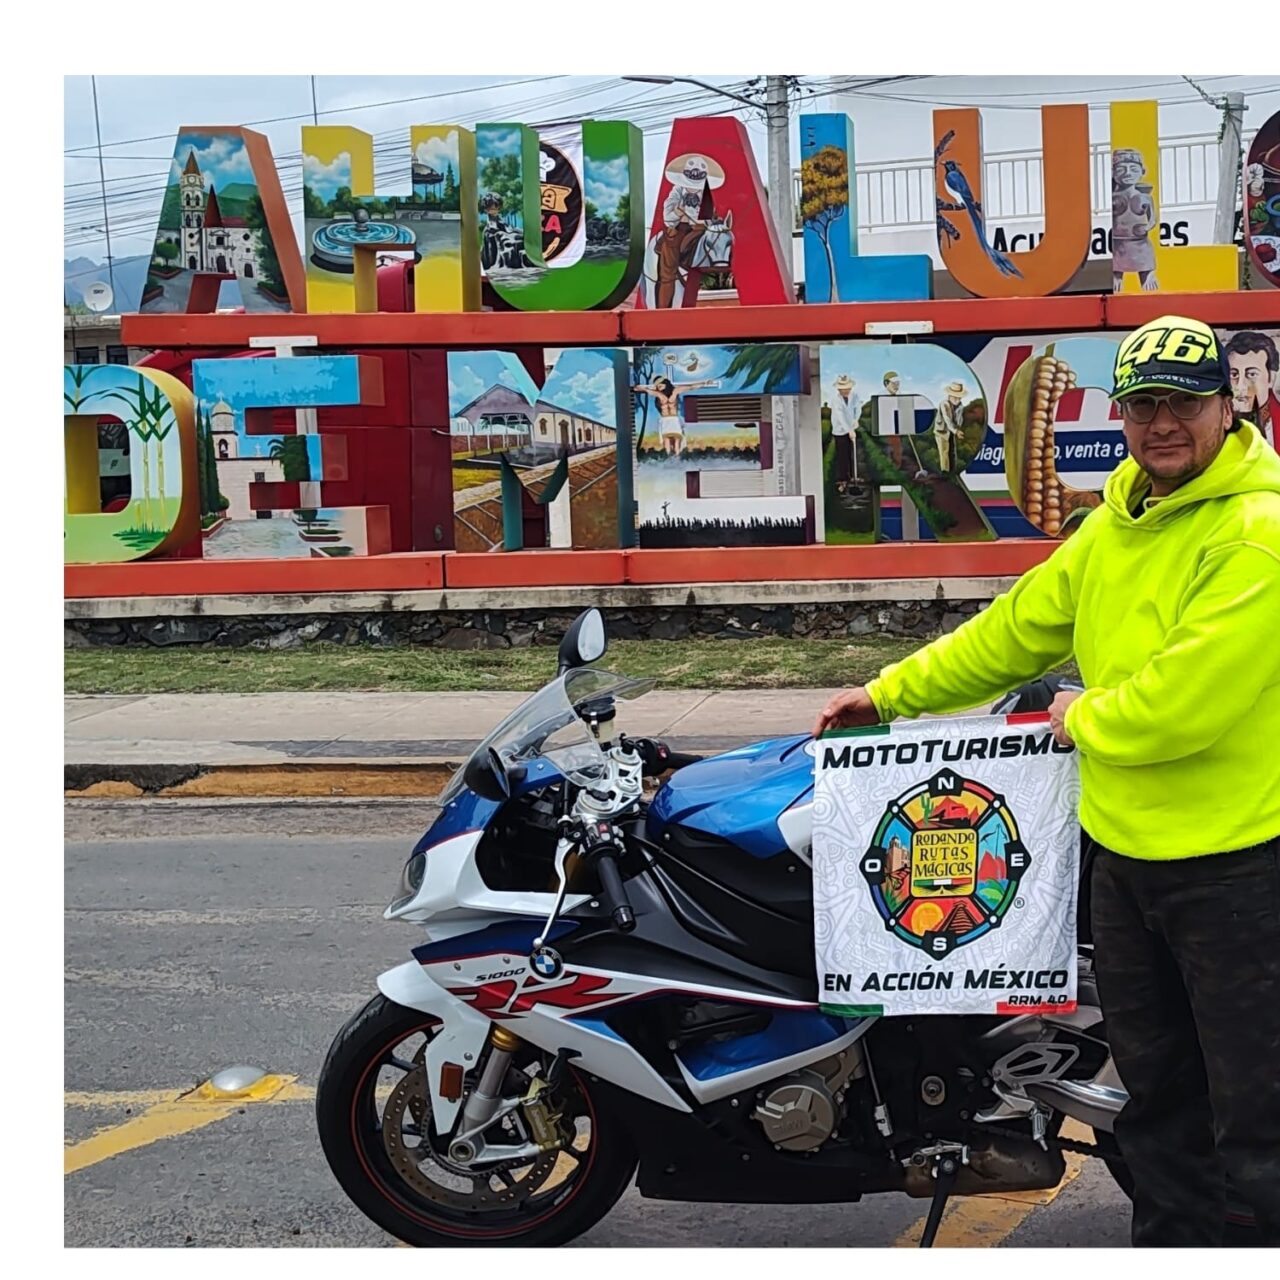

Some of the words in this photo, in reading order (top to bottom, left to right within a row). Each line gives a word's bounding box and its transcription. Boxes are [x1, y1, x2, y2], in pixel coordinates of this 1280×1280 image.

[1120, 327, 1212, 366] 46
[1065, 441, 1110, 459] venta
[1114, 443, 1124, 458] e
[822, 733, 1075, 770] MOTOTURISMO
[938, 776, 955, 790] N
[1011, 853, 1024, 867] E
[932, 937, 947, 951] S
[474, 967, 526, 982] S1000
[824, 974, 852, 992] EN
[861, 965, 953, 992] ACCIÓN
[963, 963, 1069, 990] MÉXICO
[1008, 995, 1043, 1006] RRM
